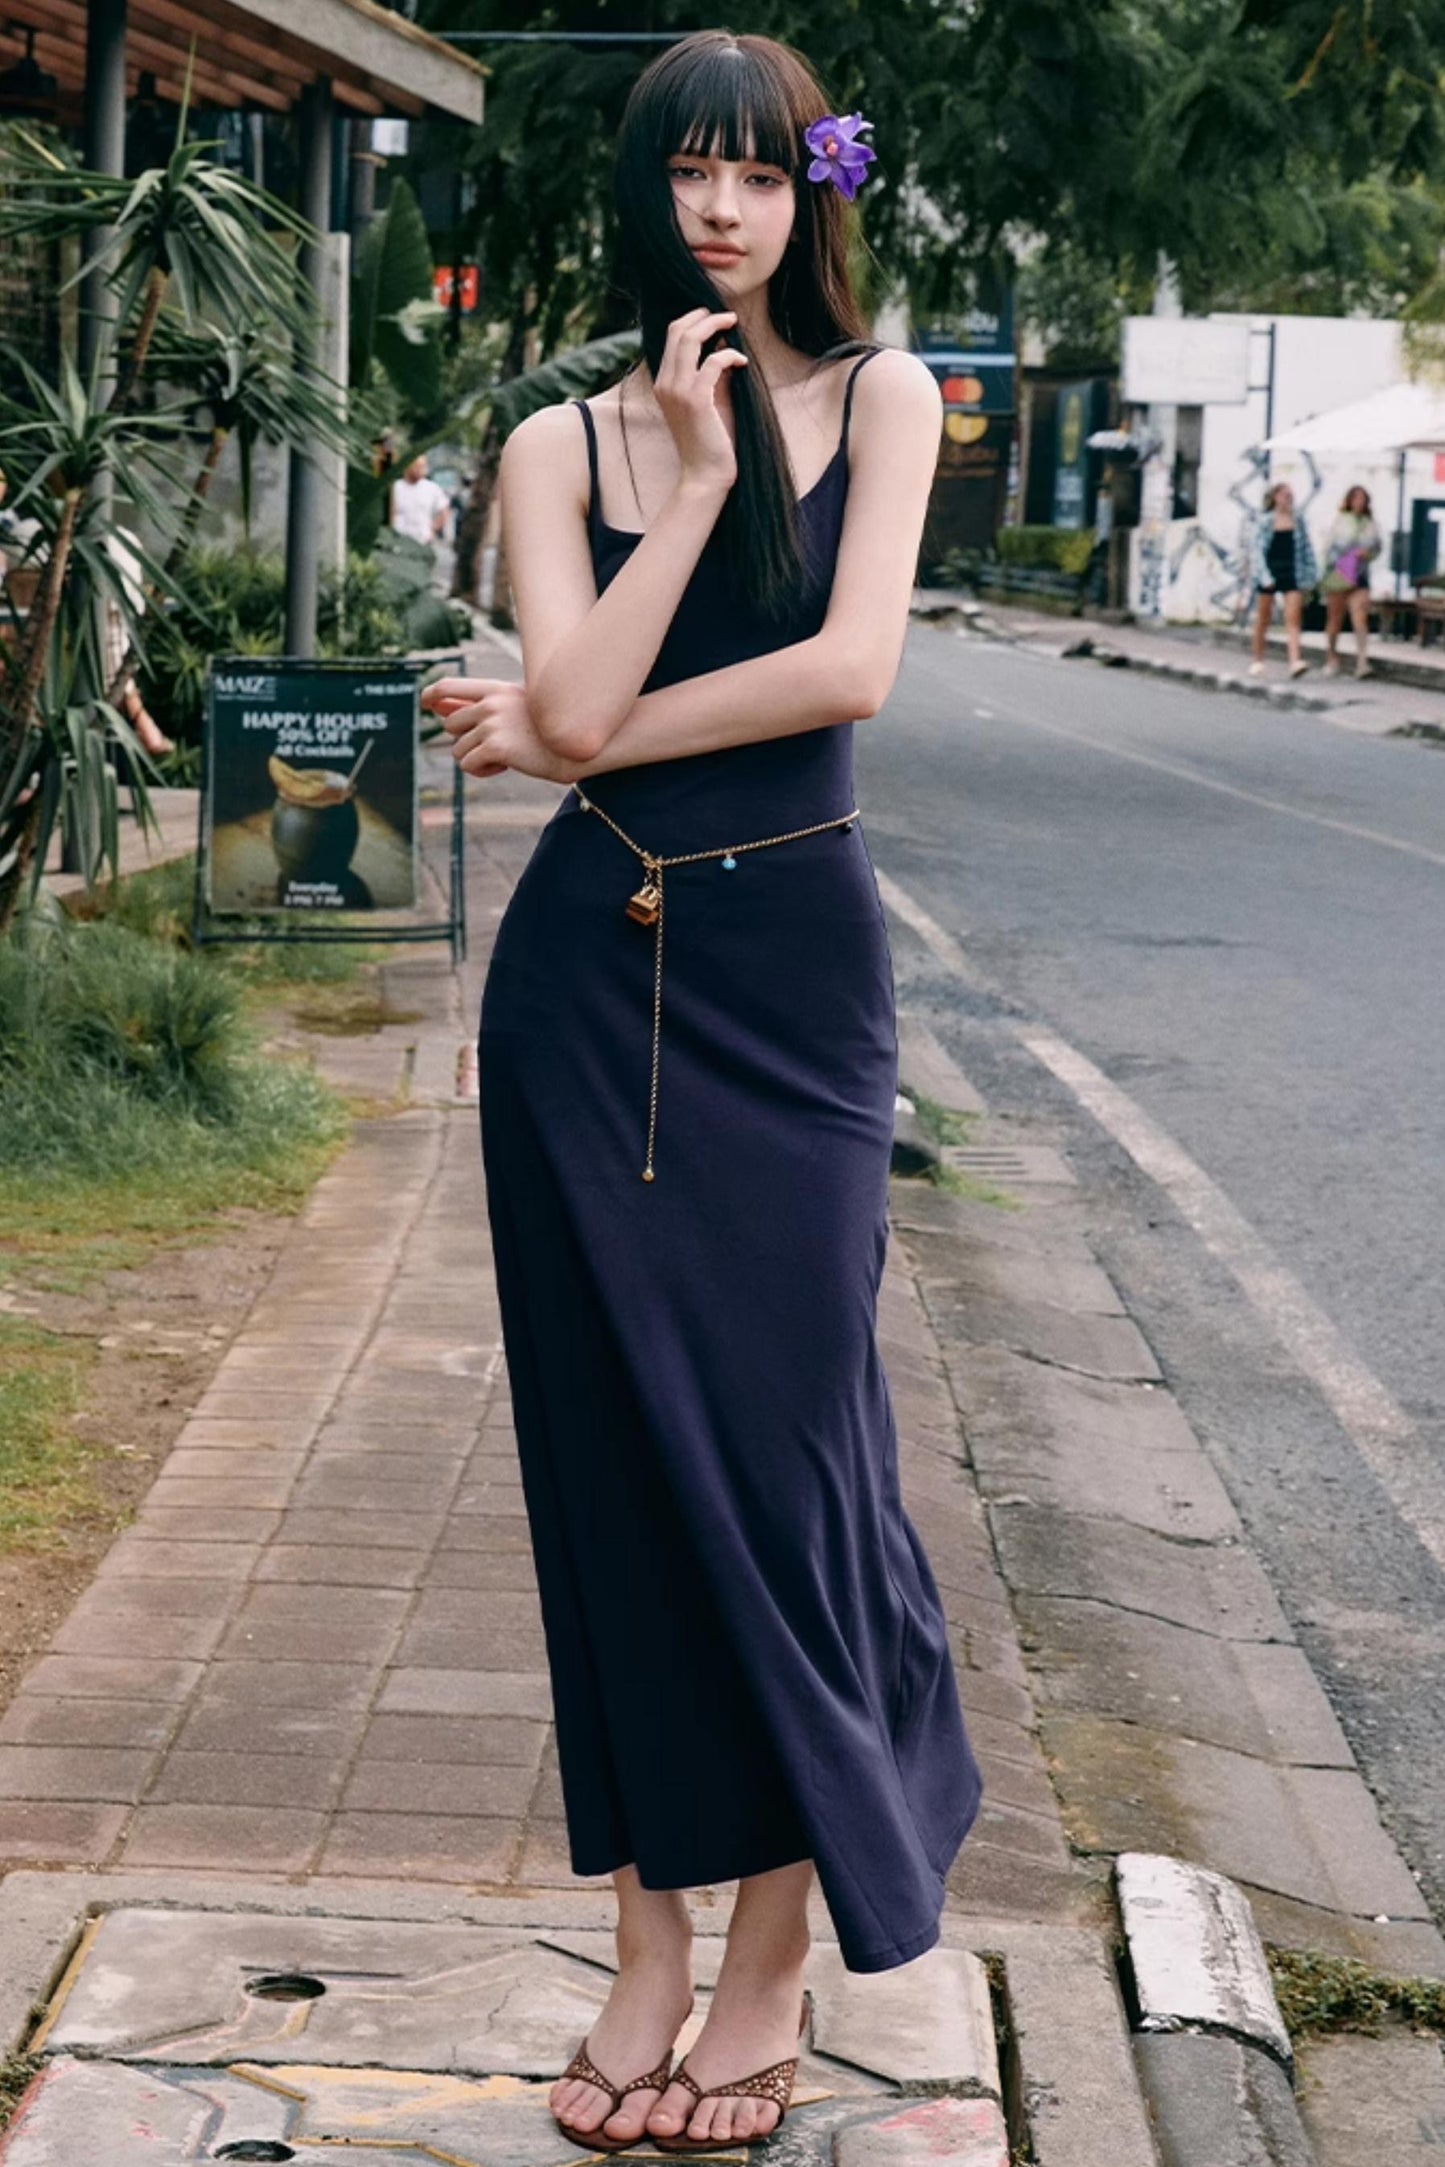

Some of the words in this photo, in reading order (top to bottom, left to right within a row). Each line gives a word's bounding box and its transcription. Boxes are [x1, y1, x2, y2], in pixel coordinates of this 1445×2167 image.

[243, 712, 311, 729] HAPPY
[314, 712, 388, 730] HOURS
[316, 729, 351, 743] OFF
[294, 744, 355, 758] Cocktails
